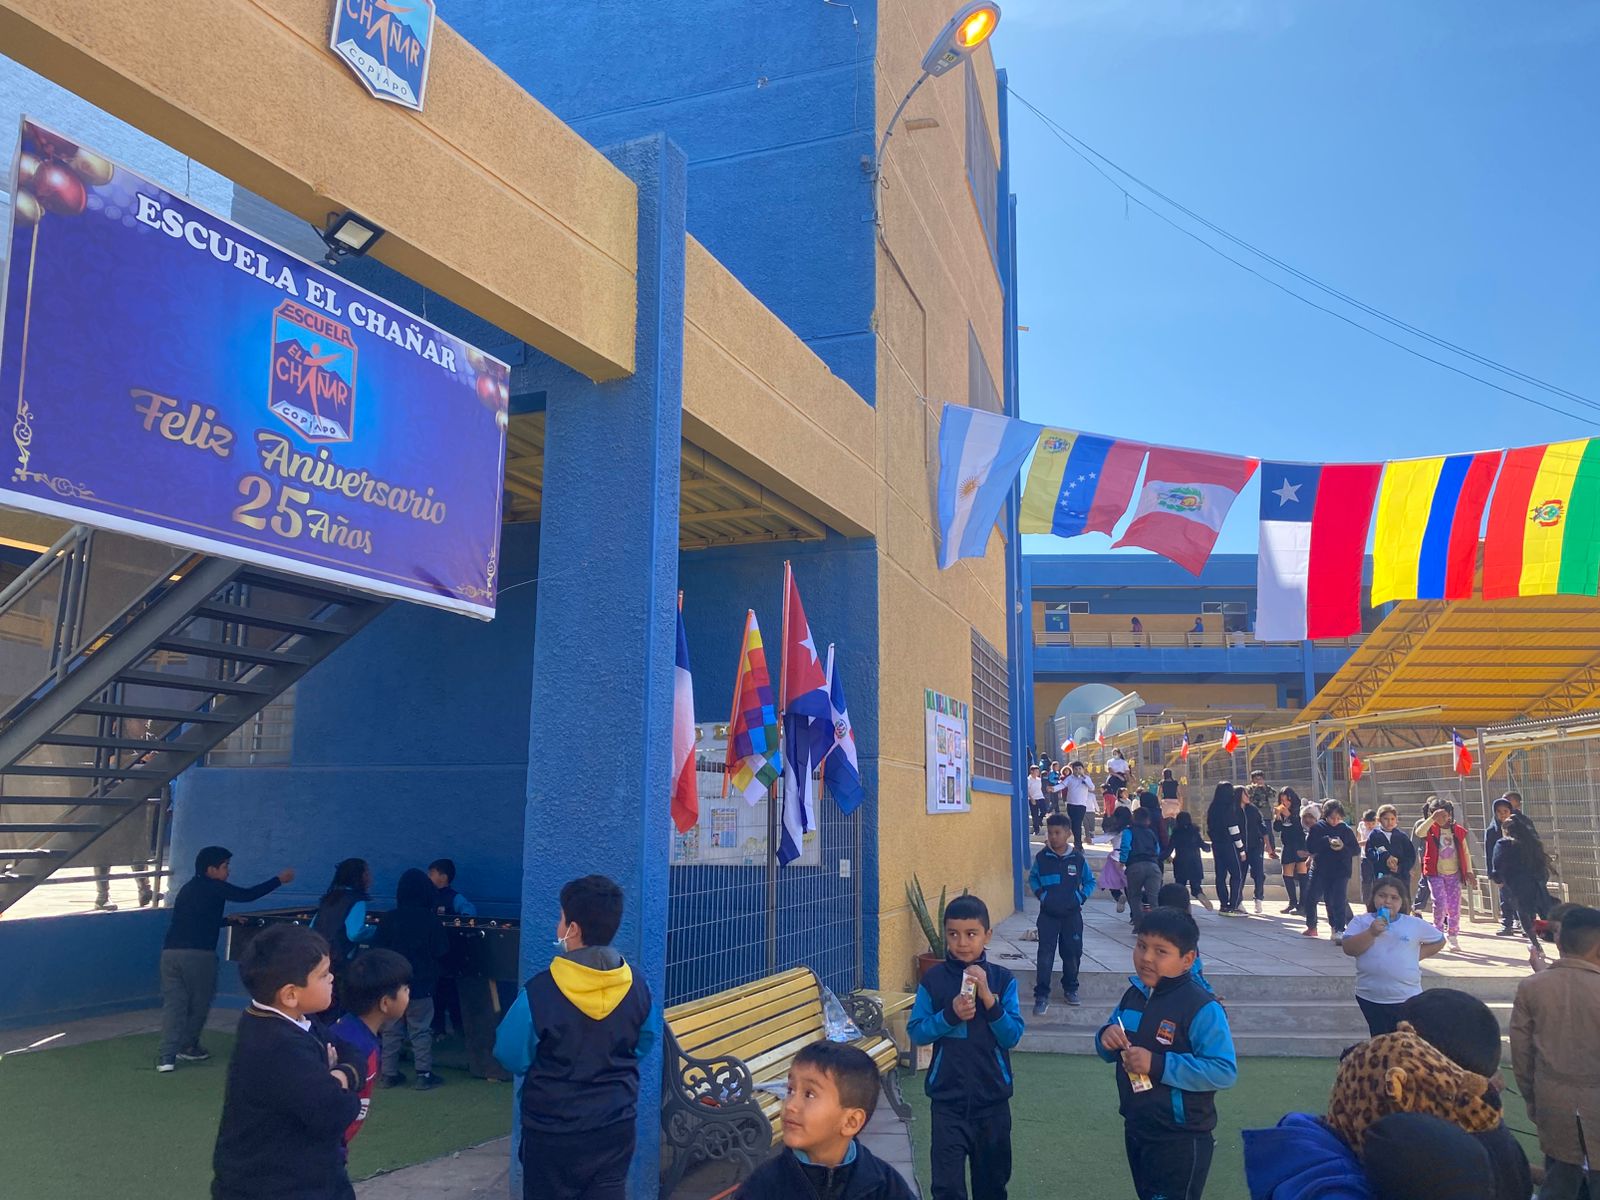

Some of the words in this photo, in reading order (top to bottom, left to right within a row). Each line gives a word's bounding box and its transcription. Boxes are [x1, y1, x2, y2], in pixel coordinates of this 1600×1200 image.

[136, 193, 298, 296] ESCUELA
[305, 278, 342, 317] EL
[348, 301, 456, 373] CHAÑAR
[279, 303, 354, 348] ESCUELA
[288, 344, 302, 362] EL
[282, 407, 336, 434] COPIAPO
[130, 389, 233, 457] Feliz
[258, 433, 446, 524] Aniversario
[232, 475, 310, 538] 25
[306, 509, 372, 554] Años
